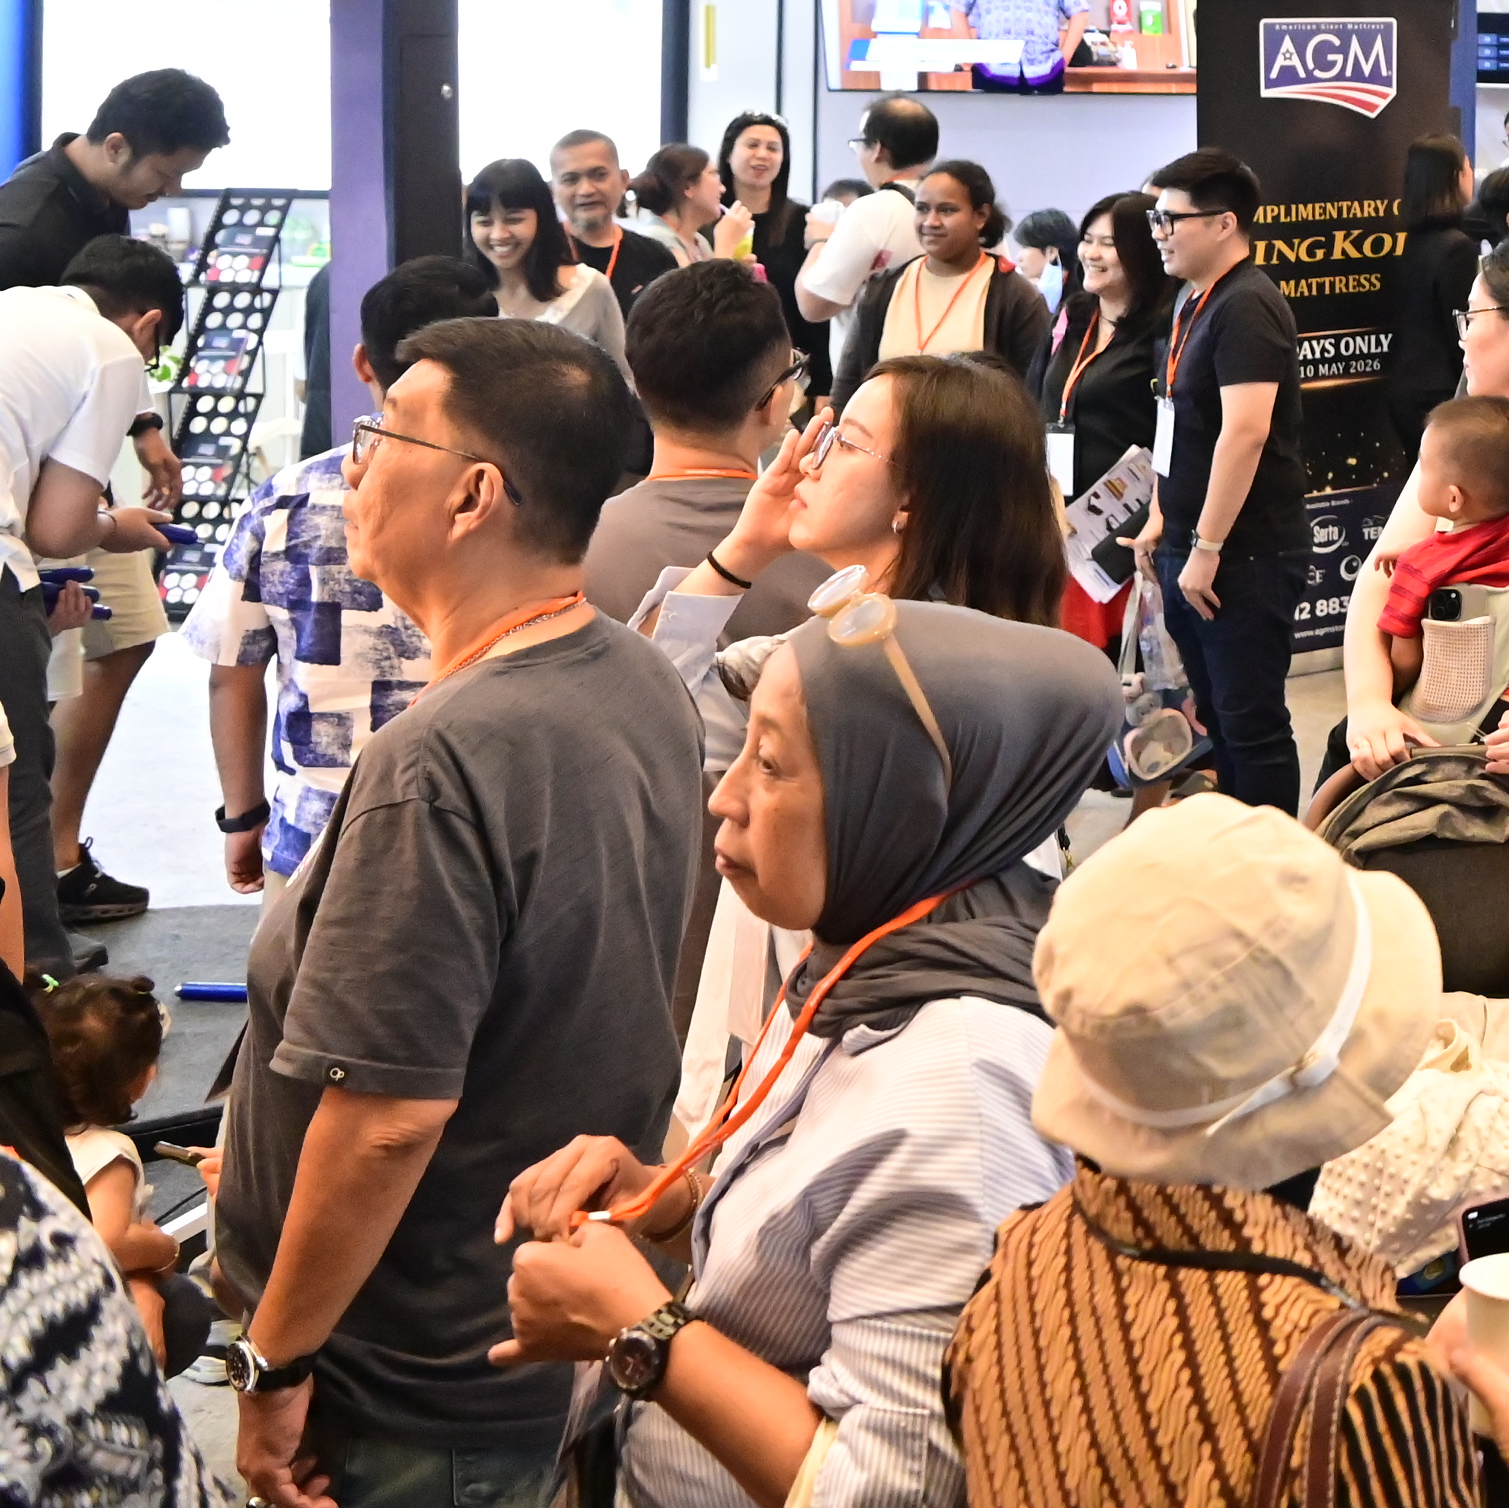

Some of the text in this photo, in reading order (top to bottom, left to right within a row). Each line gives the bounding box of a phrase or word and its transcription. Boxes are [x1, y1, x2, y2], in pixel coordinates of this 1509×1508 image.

[1269, 33, 1388, 80] AGM
[1253, 199, 1389, 224] MPLIMENTARY
[1280, 273, 1382, 298] MATTRESS
[1296, 333, 1393, 360] AYS ONLY
[1318, 361, 1346, 377] MAY
[1349, 358, 1382, 374] 2026
[1313, 525, 1339, 544] Serta
